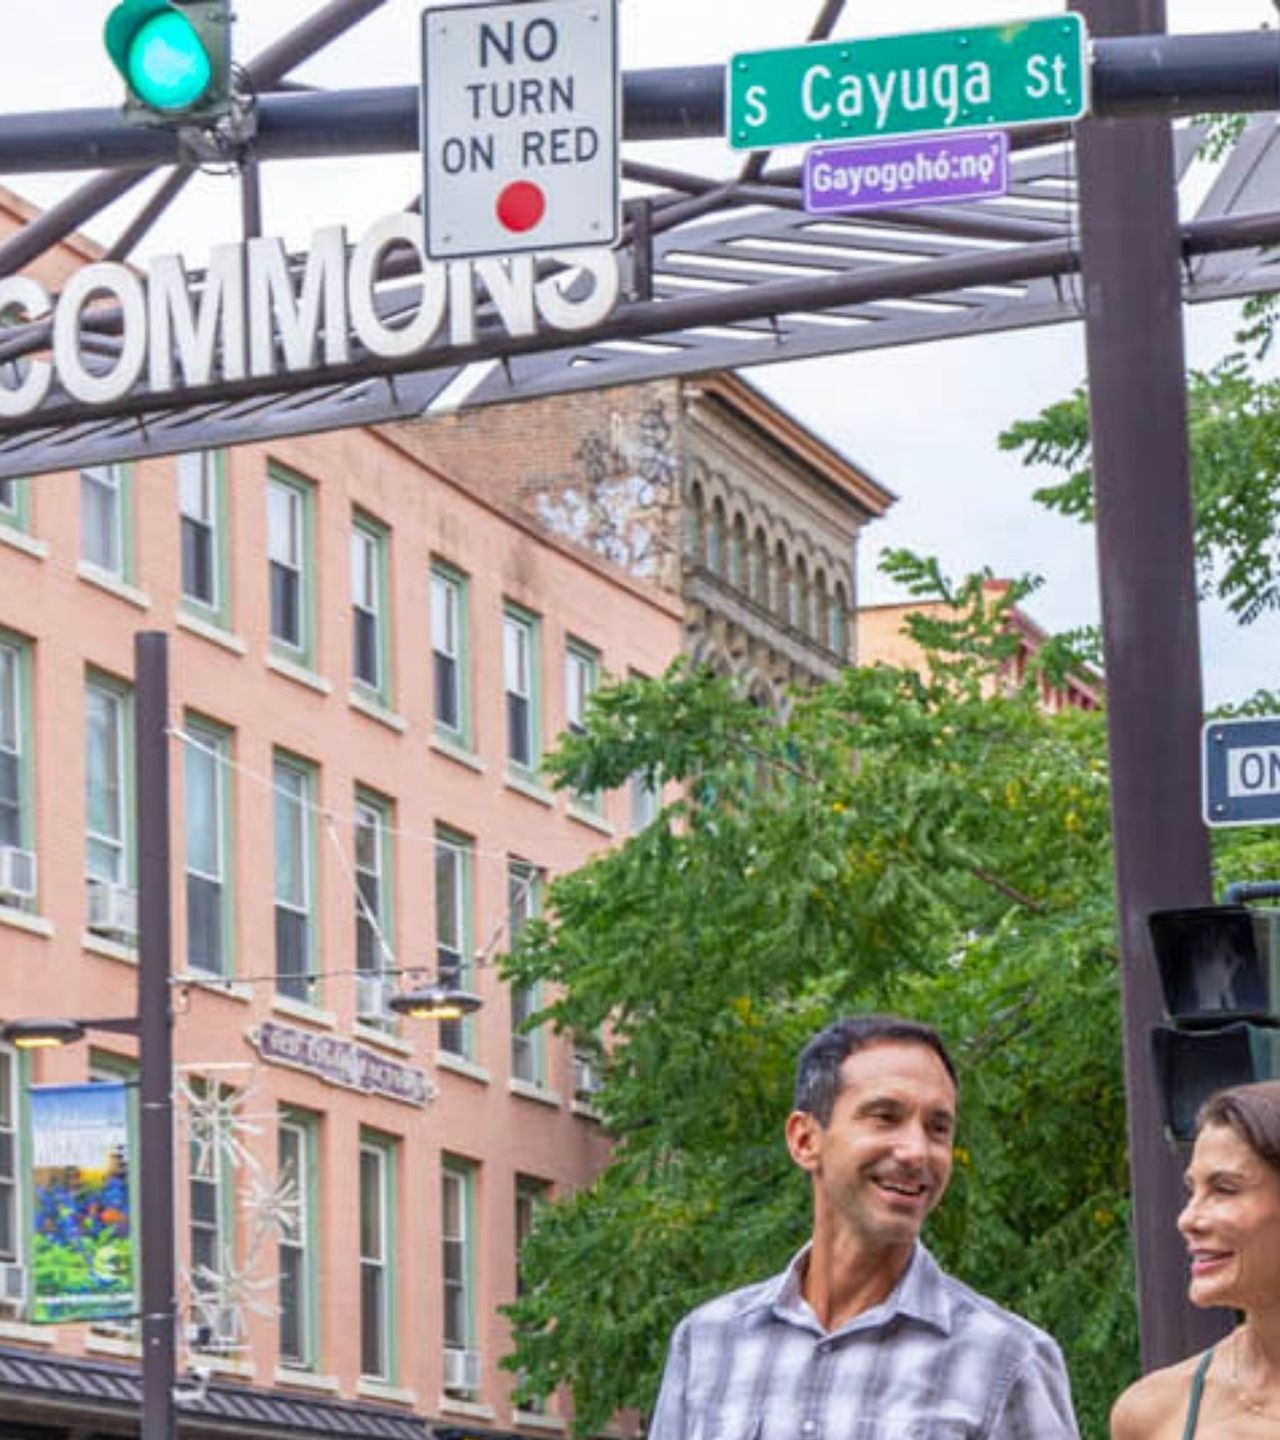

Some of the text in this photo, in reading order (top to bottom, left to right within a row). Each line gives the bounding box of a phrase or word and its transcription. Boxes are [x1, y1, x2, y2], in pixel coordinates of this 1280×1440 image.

[480, 18, 557, 68] NO
[466, 75, 574, 120] TURN
[744, 54, 1068, 129] S Cayuga St
[442, 126, 598, 174] ON RED
